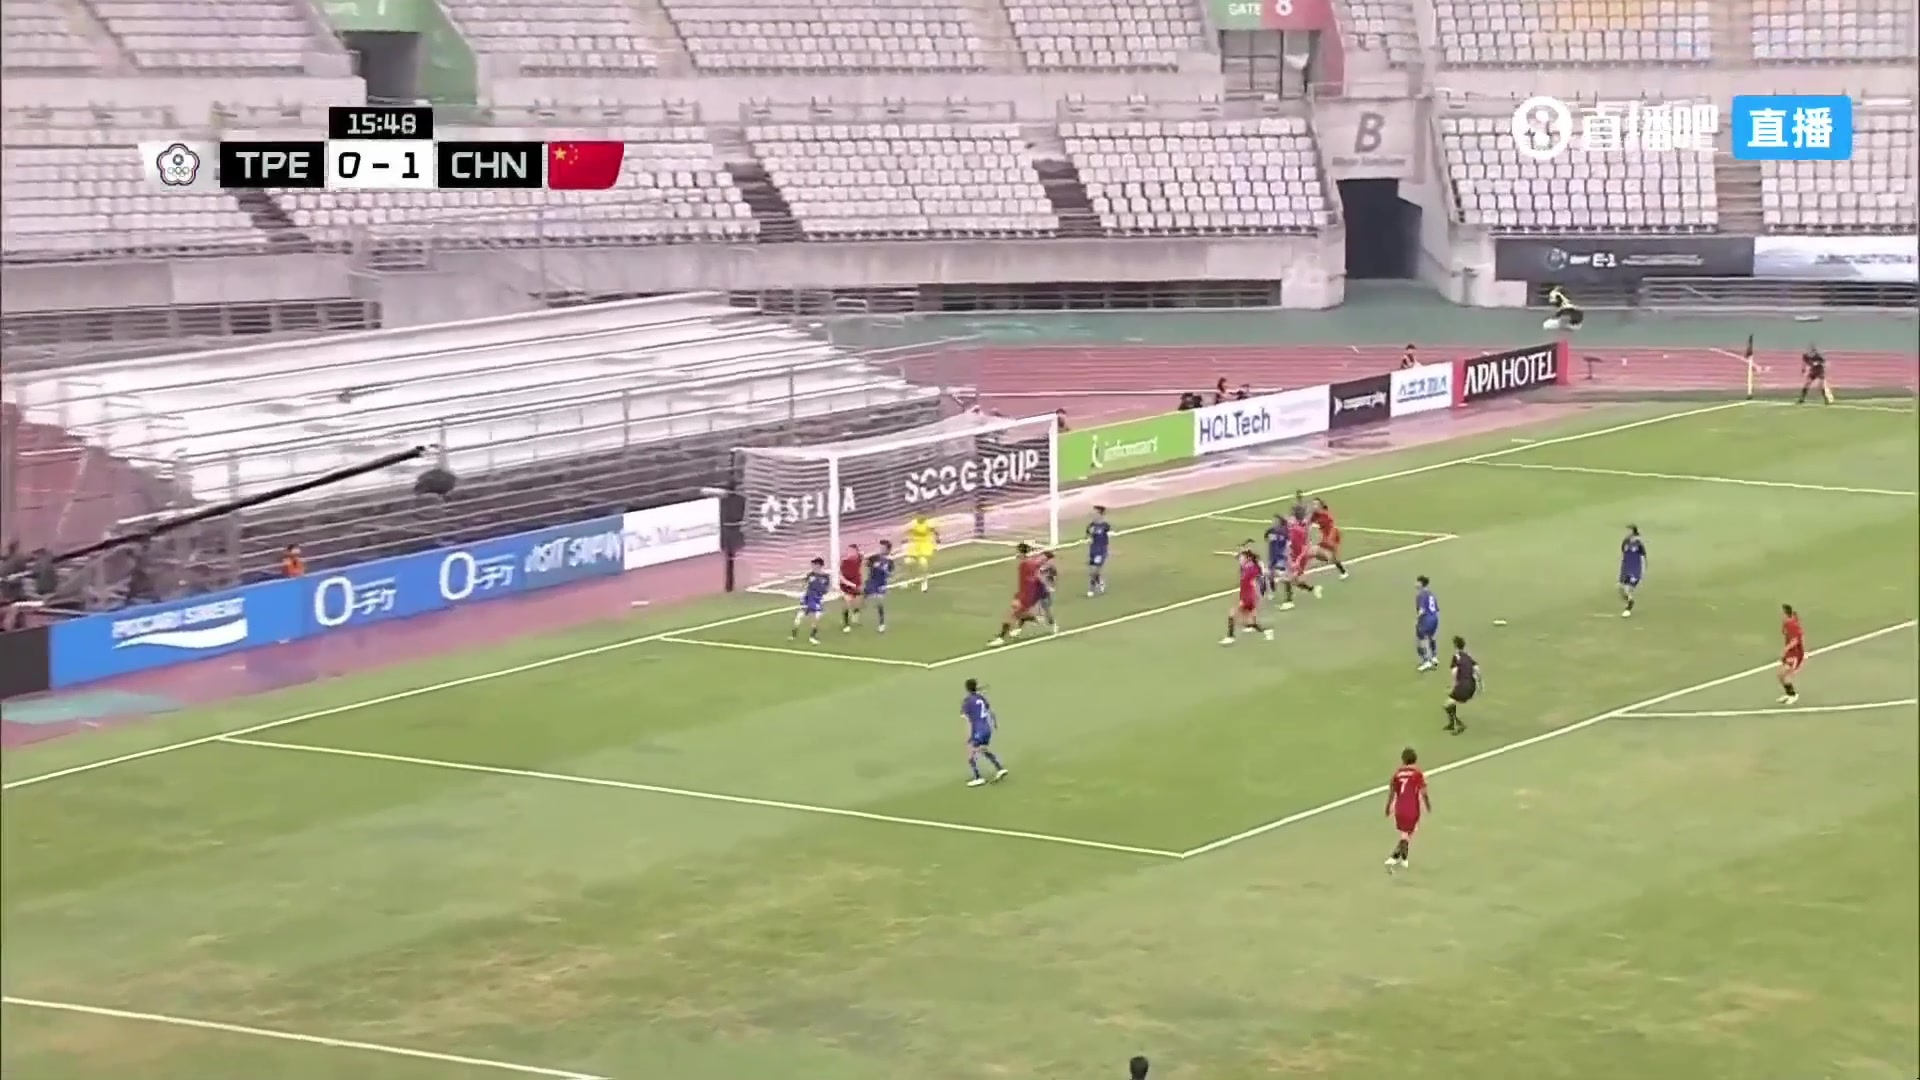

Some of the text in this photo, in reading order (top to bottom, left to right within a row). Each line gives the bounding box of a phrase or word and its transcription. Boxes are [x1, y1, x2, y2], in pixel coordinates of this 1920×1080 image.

[1354, 112, 1385, 153] B
[1463, 363, 1500, 396] APA
[1501, 351, 1557, 388] HOTEL
[1200, 408, 1271, 442] HCLTech
[785, 486, 856, 523] SFIA
[1398, 778, 1409, 793] 7
